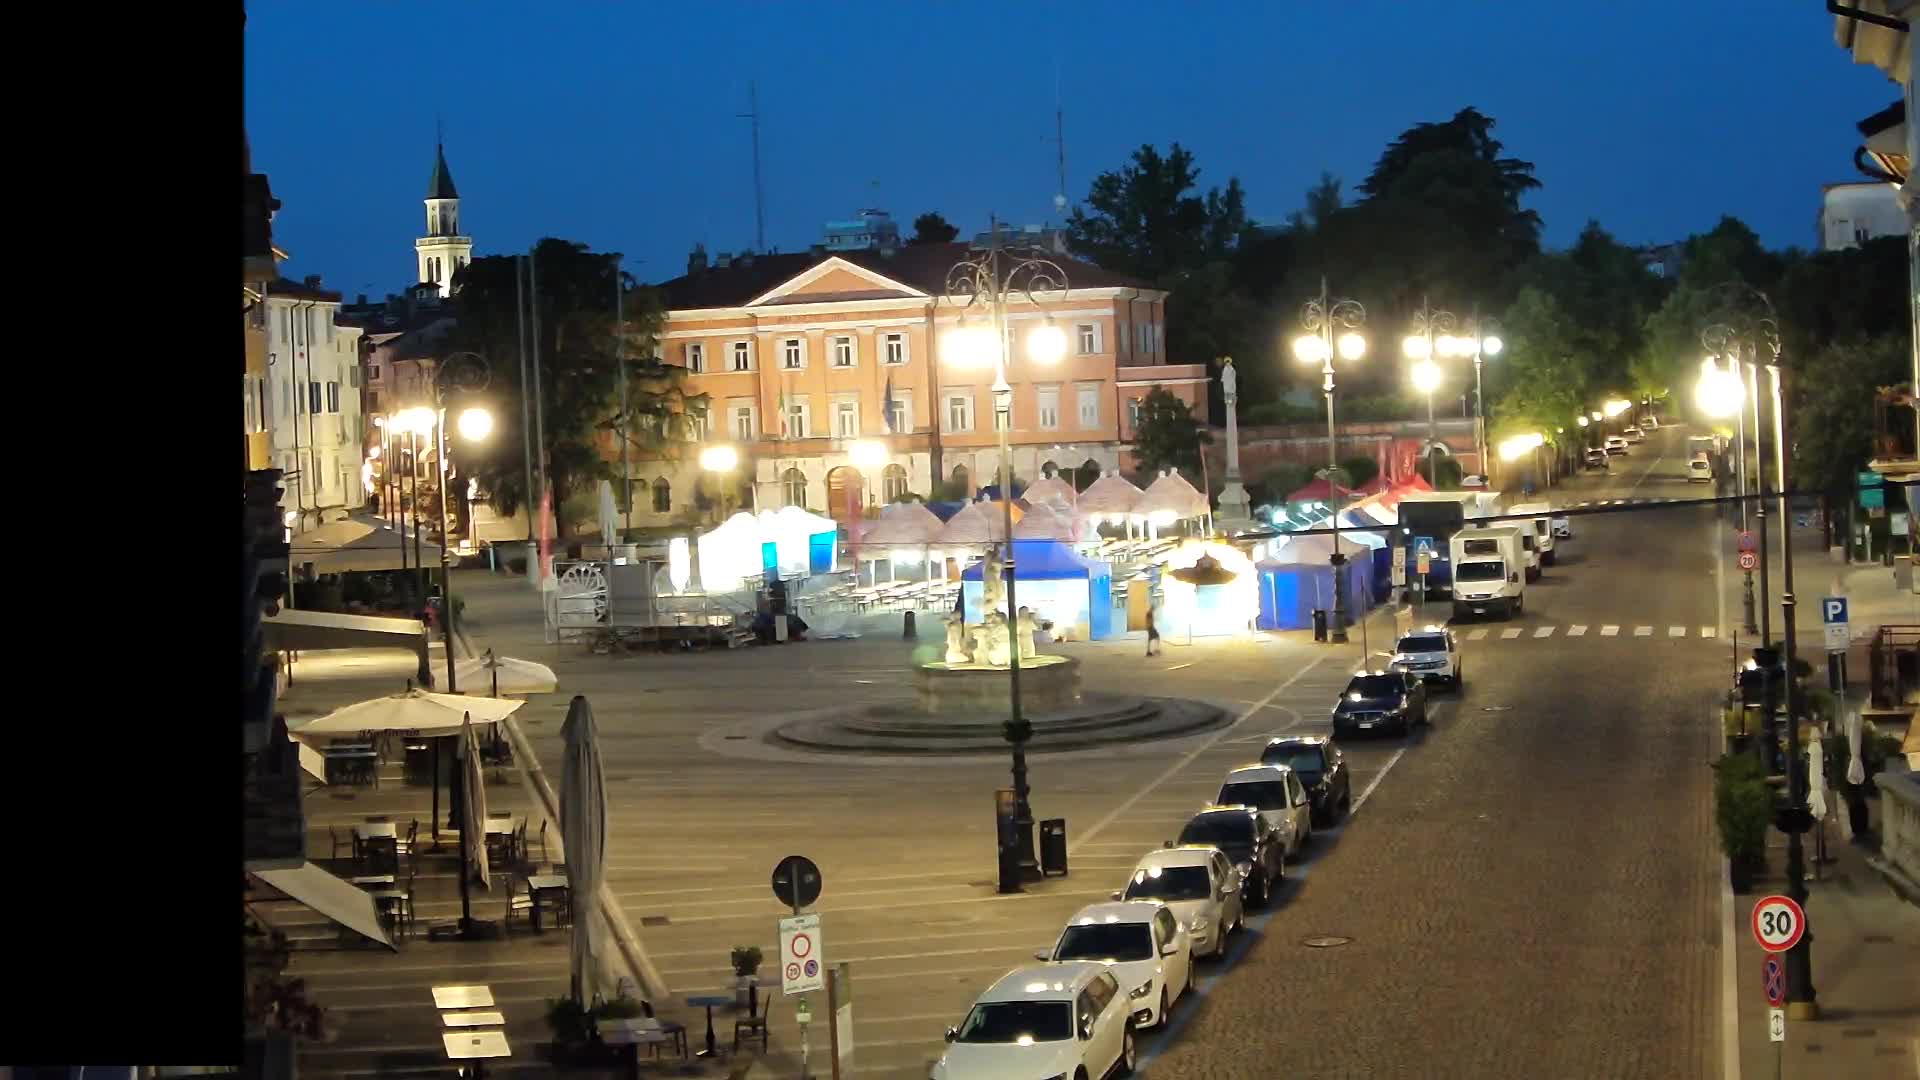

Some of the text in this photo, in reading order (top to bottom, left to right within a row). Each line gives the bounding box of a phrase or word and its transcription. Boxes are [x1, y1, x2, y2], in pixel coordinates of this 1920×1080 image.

[1743, 557, 1753, 566] 20
[1827, 601, 1843, 621] P
[1763, 911, 1791, 936] 30
